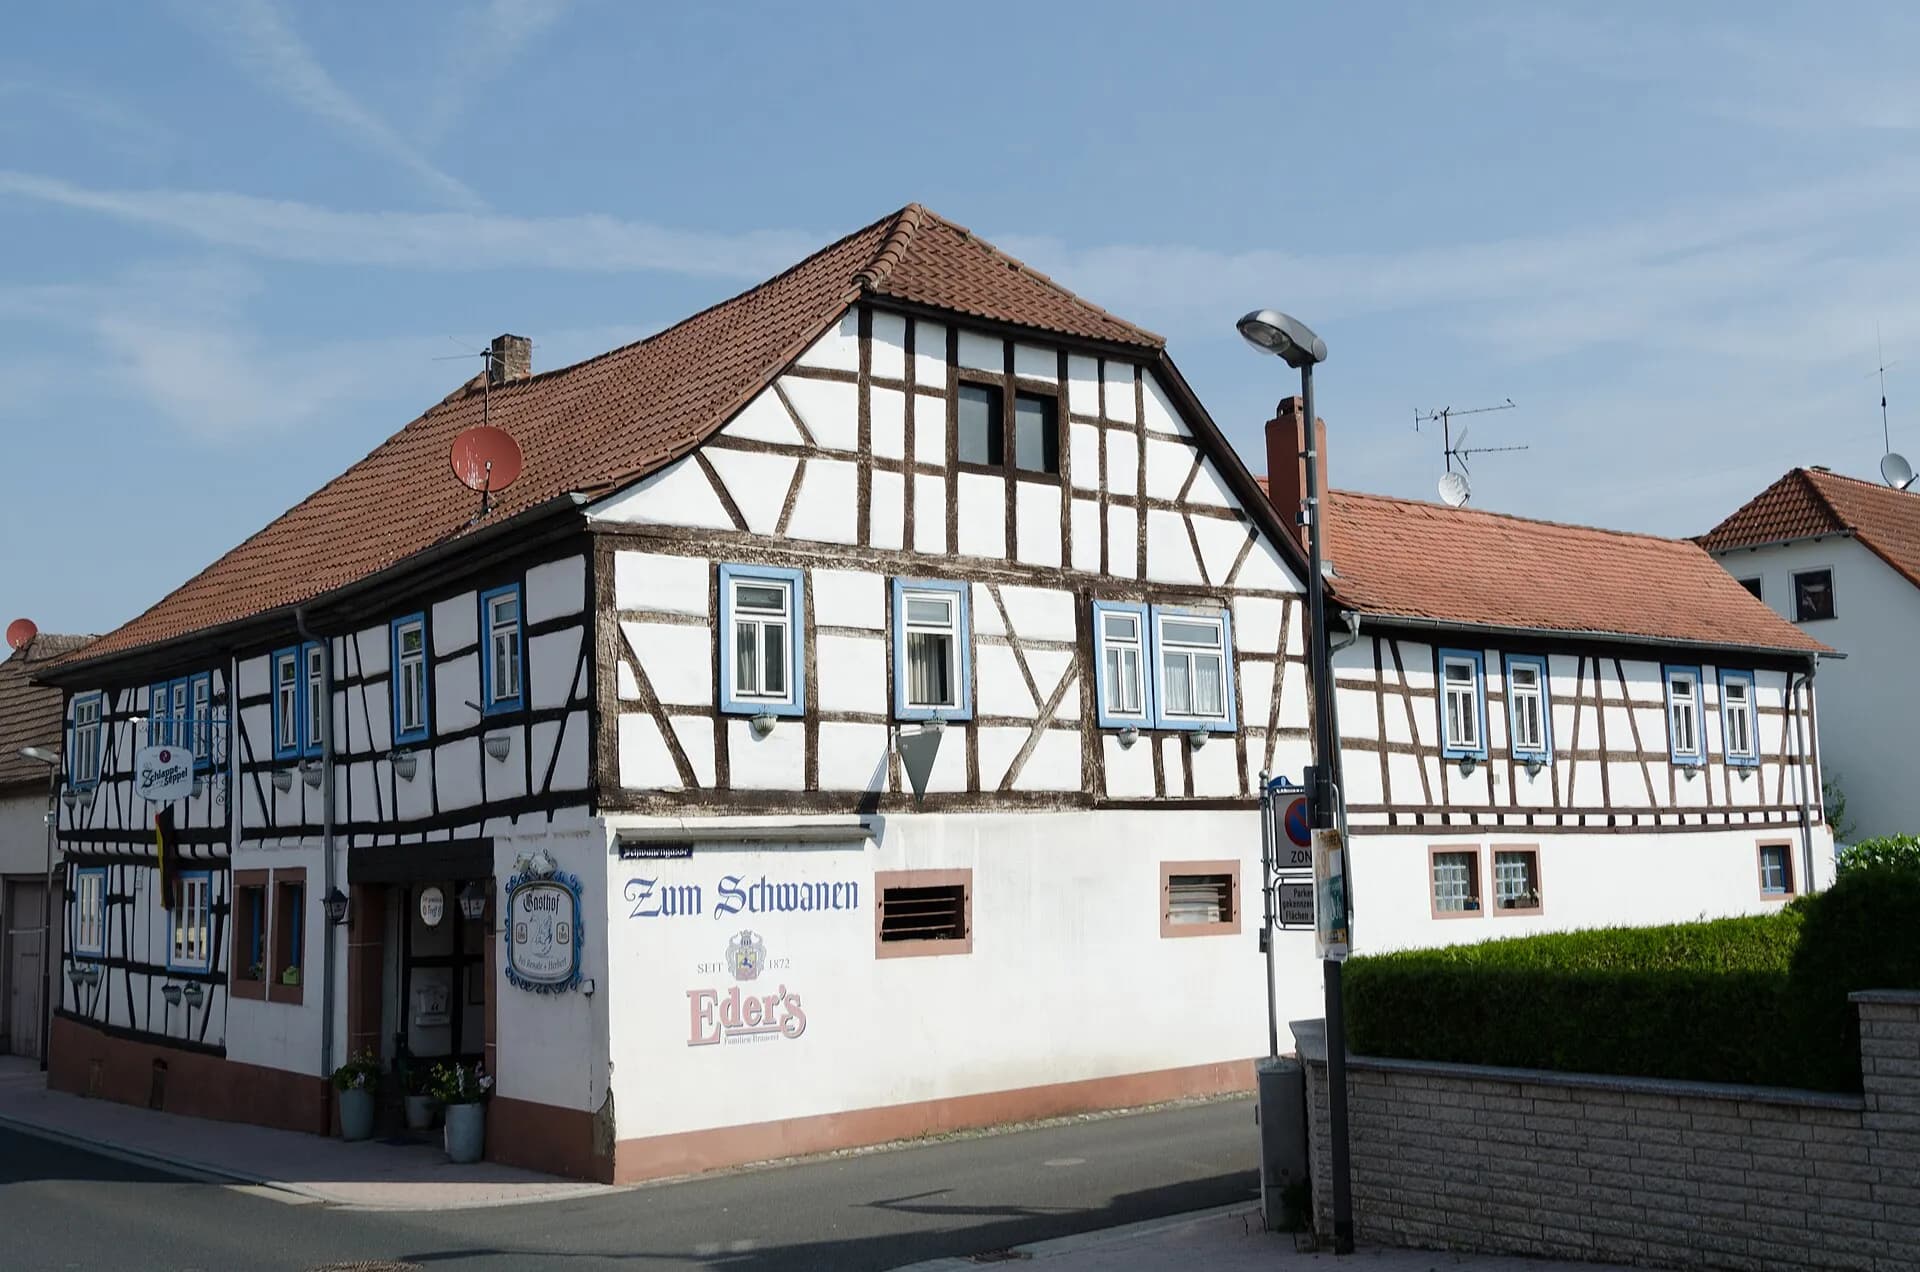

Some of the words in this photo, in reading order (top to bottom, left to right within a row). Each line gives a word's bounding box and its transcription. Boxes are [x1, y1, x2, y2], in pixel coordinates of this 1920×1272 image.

[1291, 850, 1312, 864] ZON
[523, 892, 561, 915] Gasthof
[623, 876, 702, 919] Zum
[714, 874, 859, 920] Schwanen
[697, 963, 723, 975] SEIT
[768, 958, 790, 970] 1872
[686, 984, 807, 1047] Eder's
